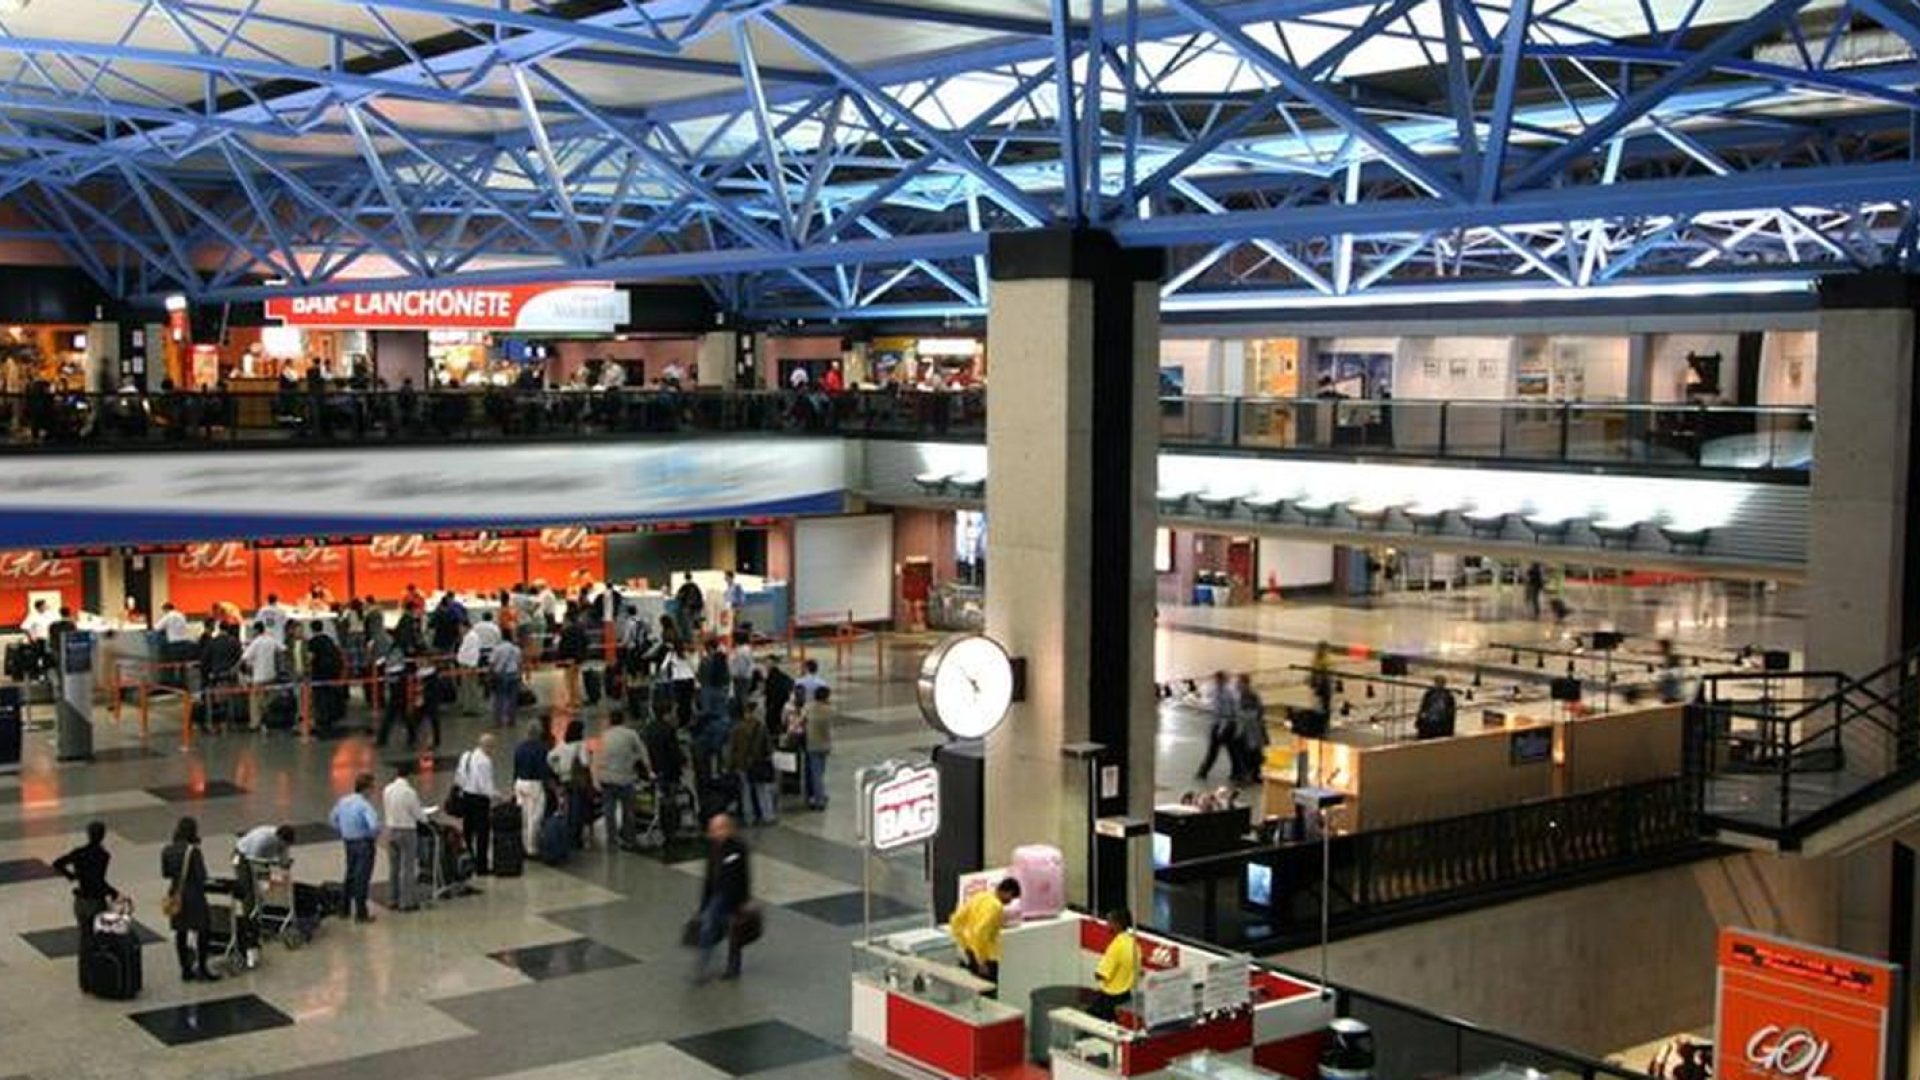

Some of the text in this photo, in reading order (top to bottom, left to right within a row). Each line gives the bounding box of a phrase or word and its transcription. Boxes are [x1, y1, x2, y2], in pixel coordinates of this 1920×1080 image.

[354, 292, 511, 318] LANCHONETE
[878, 801, 936, 841] BAG
[1746, 1024, 1833, 1080] GOL
